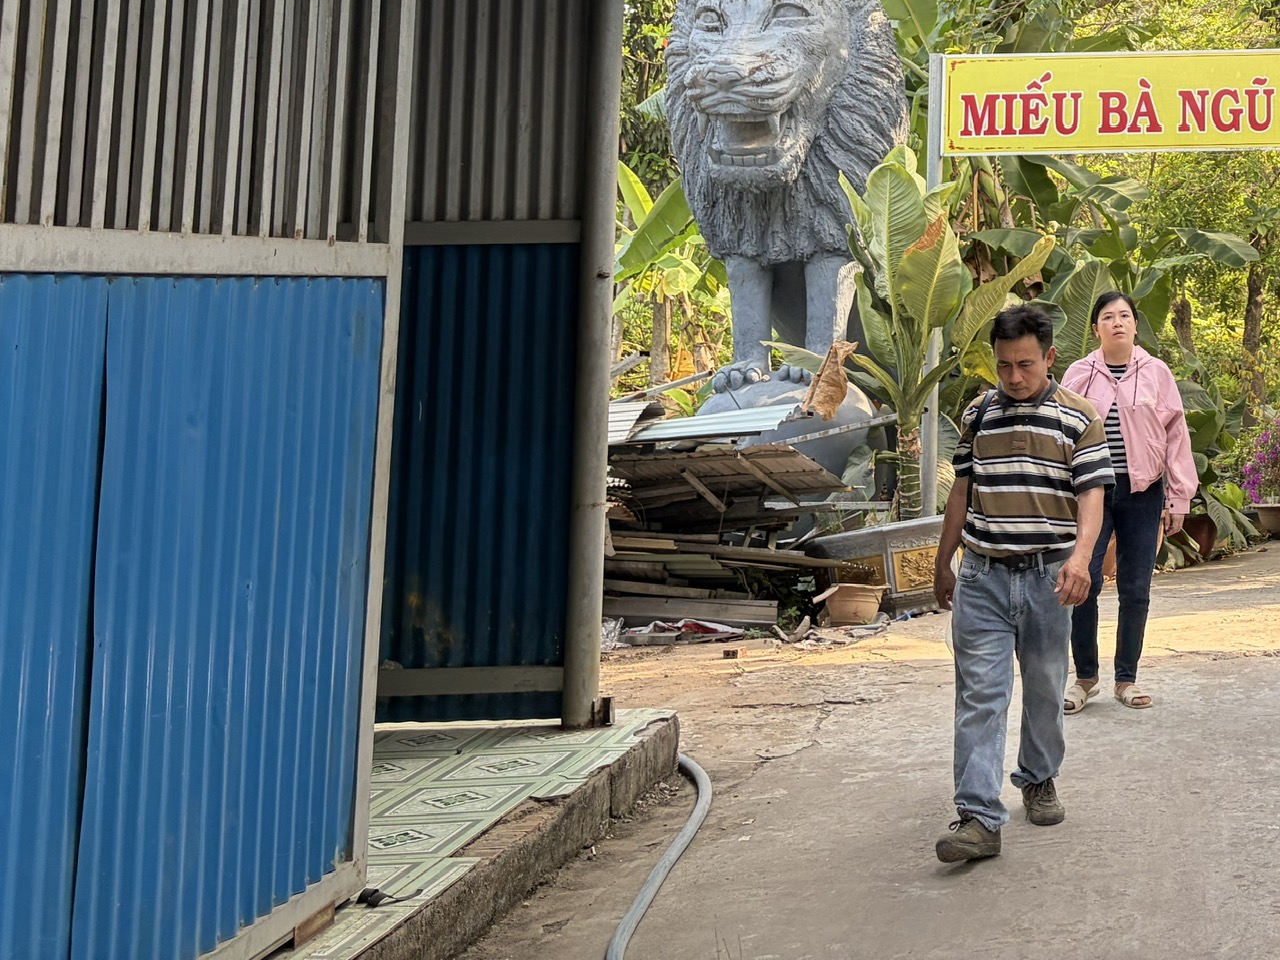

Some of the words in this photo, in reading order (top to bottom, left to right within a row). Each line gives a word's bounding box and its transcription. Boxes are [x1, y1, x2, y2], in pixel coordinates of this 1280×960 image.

[960, 72, 1082, 137] MIẾU
[1098, 78, 1163, 134] BÀ
[1178, 77, 1275, 132] NGŨ
